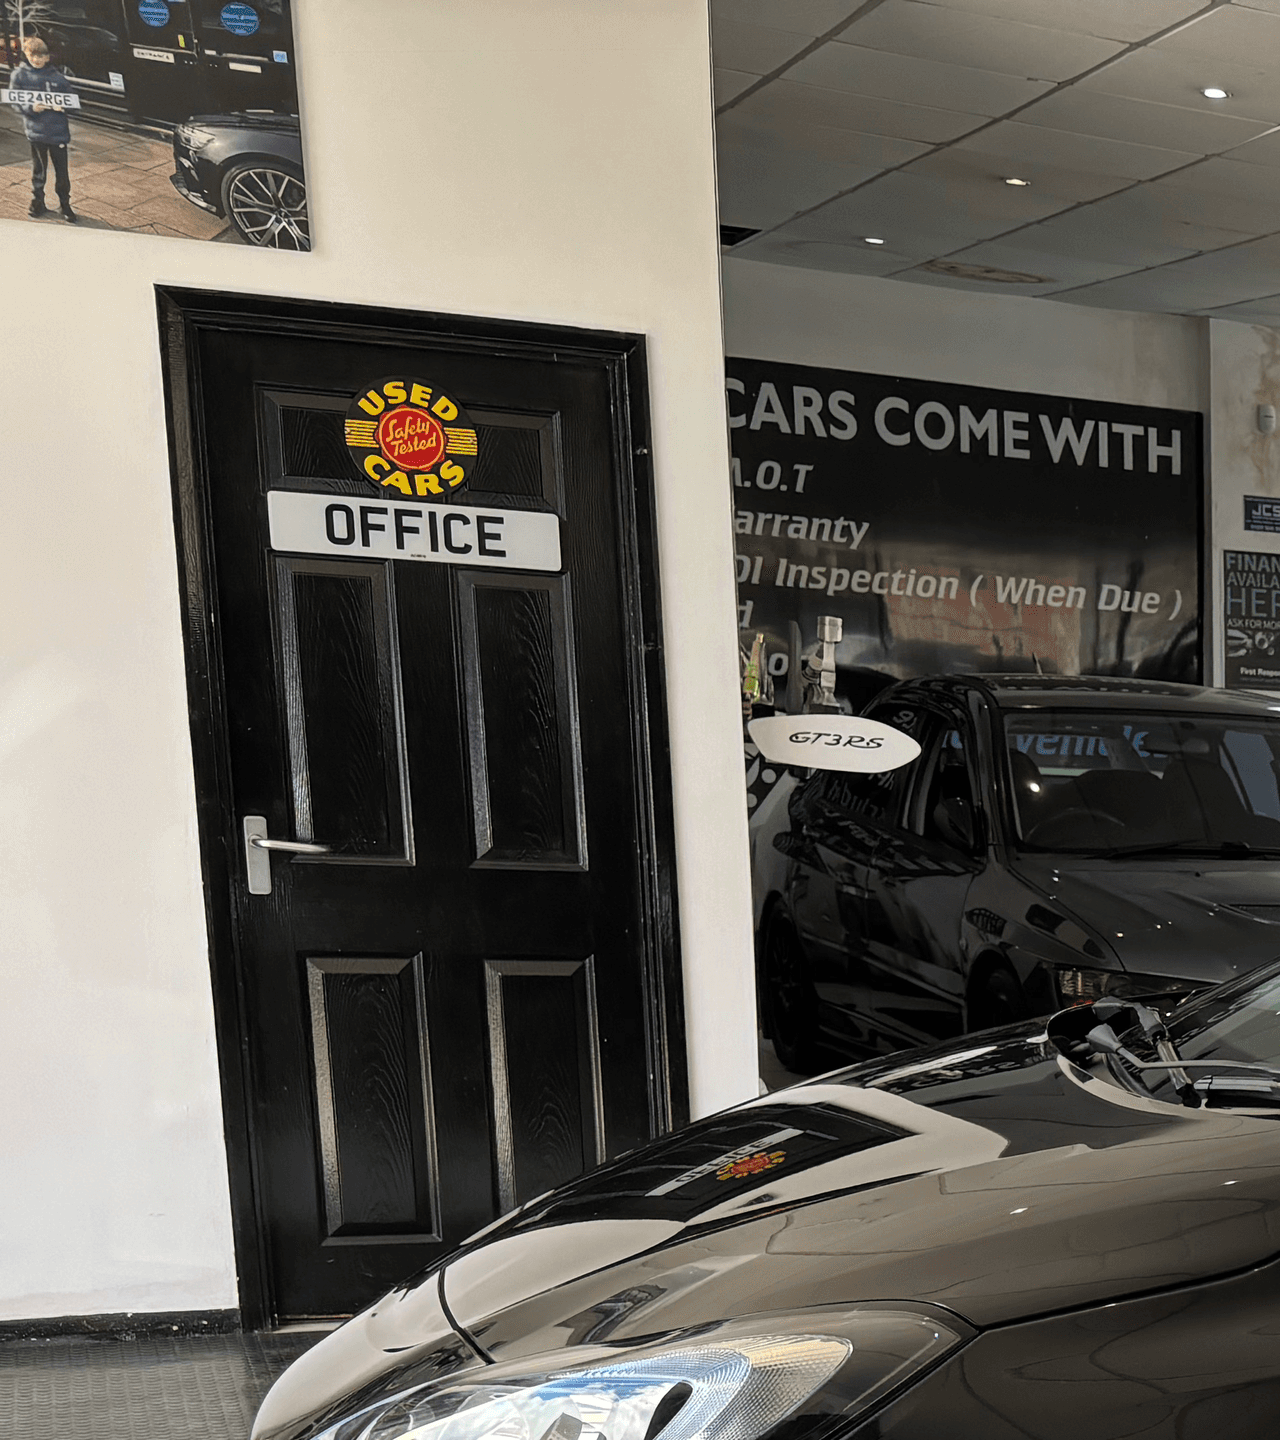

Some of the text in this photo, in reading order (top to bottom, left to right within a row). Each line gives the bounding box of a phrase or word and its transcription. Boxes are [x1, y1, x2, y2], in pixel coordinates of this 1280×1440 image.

[8, 91, 72, 106] GE24RGE
[358, 381, 458, 422] USED
[386, 415, 431, 442] Safety
[391, 431, 437, 456] Tested
[726, 377, 1182, 475] CARS COME WITH
[363, 454, 465, 497] CARS
[324, 503, 507, 558] OFFICE
[735, 510, 870, 550] arranty
[775, 557, 959, 601] Inspection
[994, 575, 1086, 610] When
[1096, 583, 1162, 614] Due
[1227, 618, 1245, 628] ASK
[1245, 619, 1262, 629] FOR
